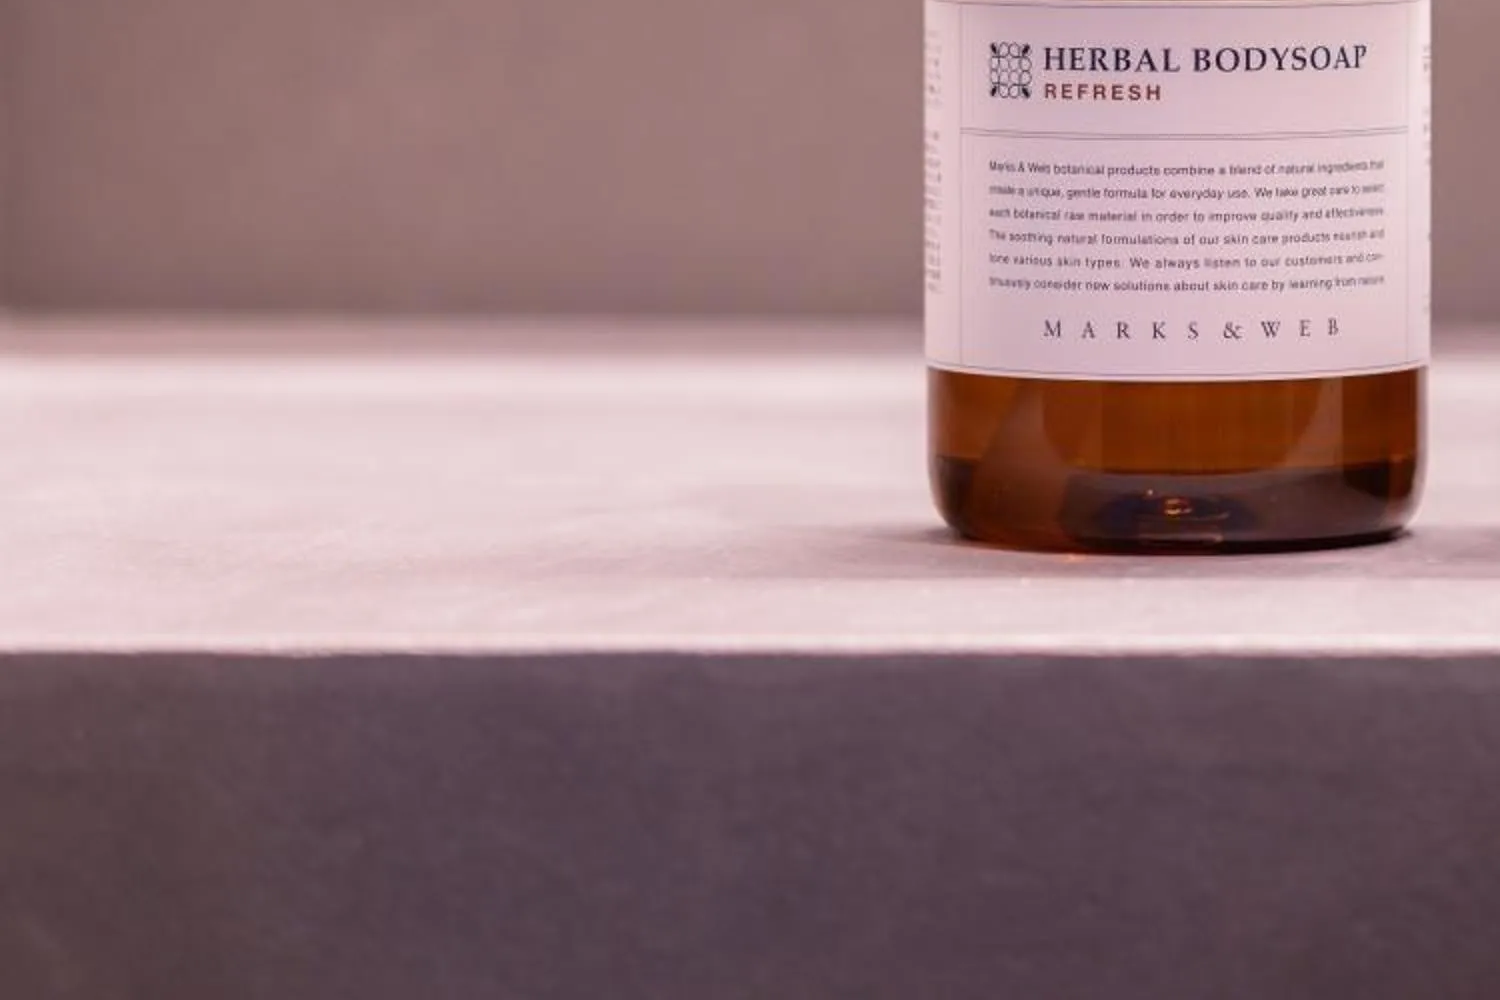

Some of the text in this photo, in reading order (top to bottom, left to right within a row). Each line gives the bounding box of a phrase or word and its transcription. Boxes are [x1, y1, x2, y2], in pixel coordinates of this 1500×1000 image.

[1042, 44, 1368, 73] HERBAL BODYSOAP
[1043, 83, 1162, 101] REFRESH
[1108, 165, 1160, 178] products
